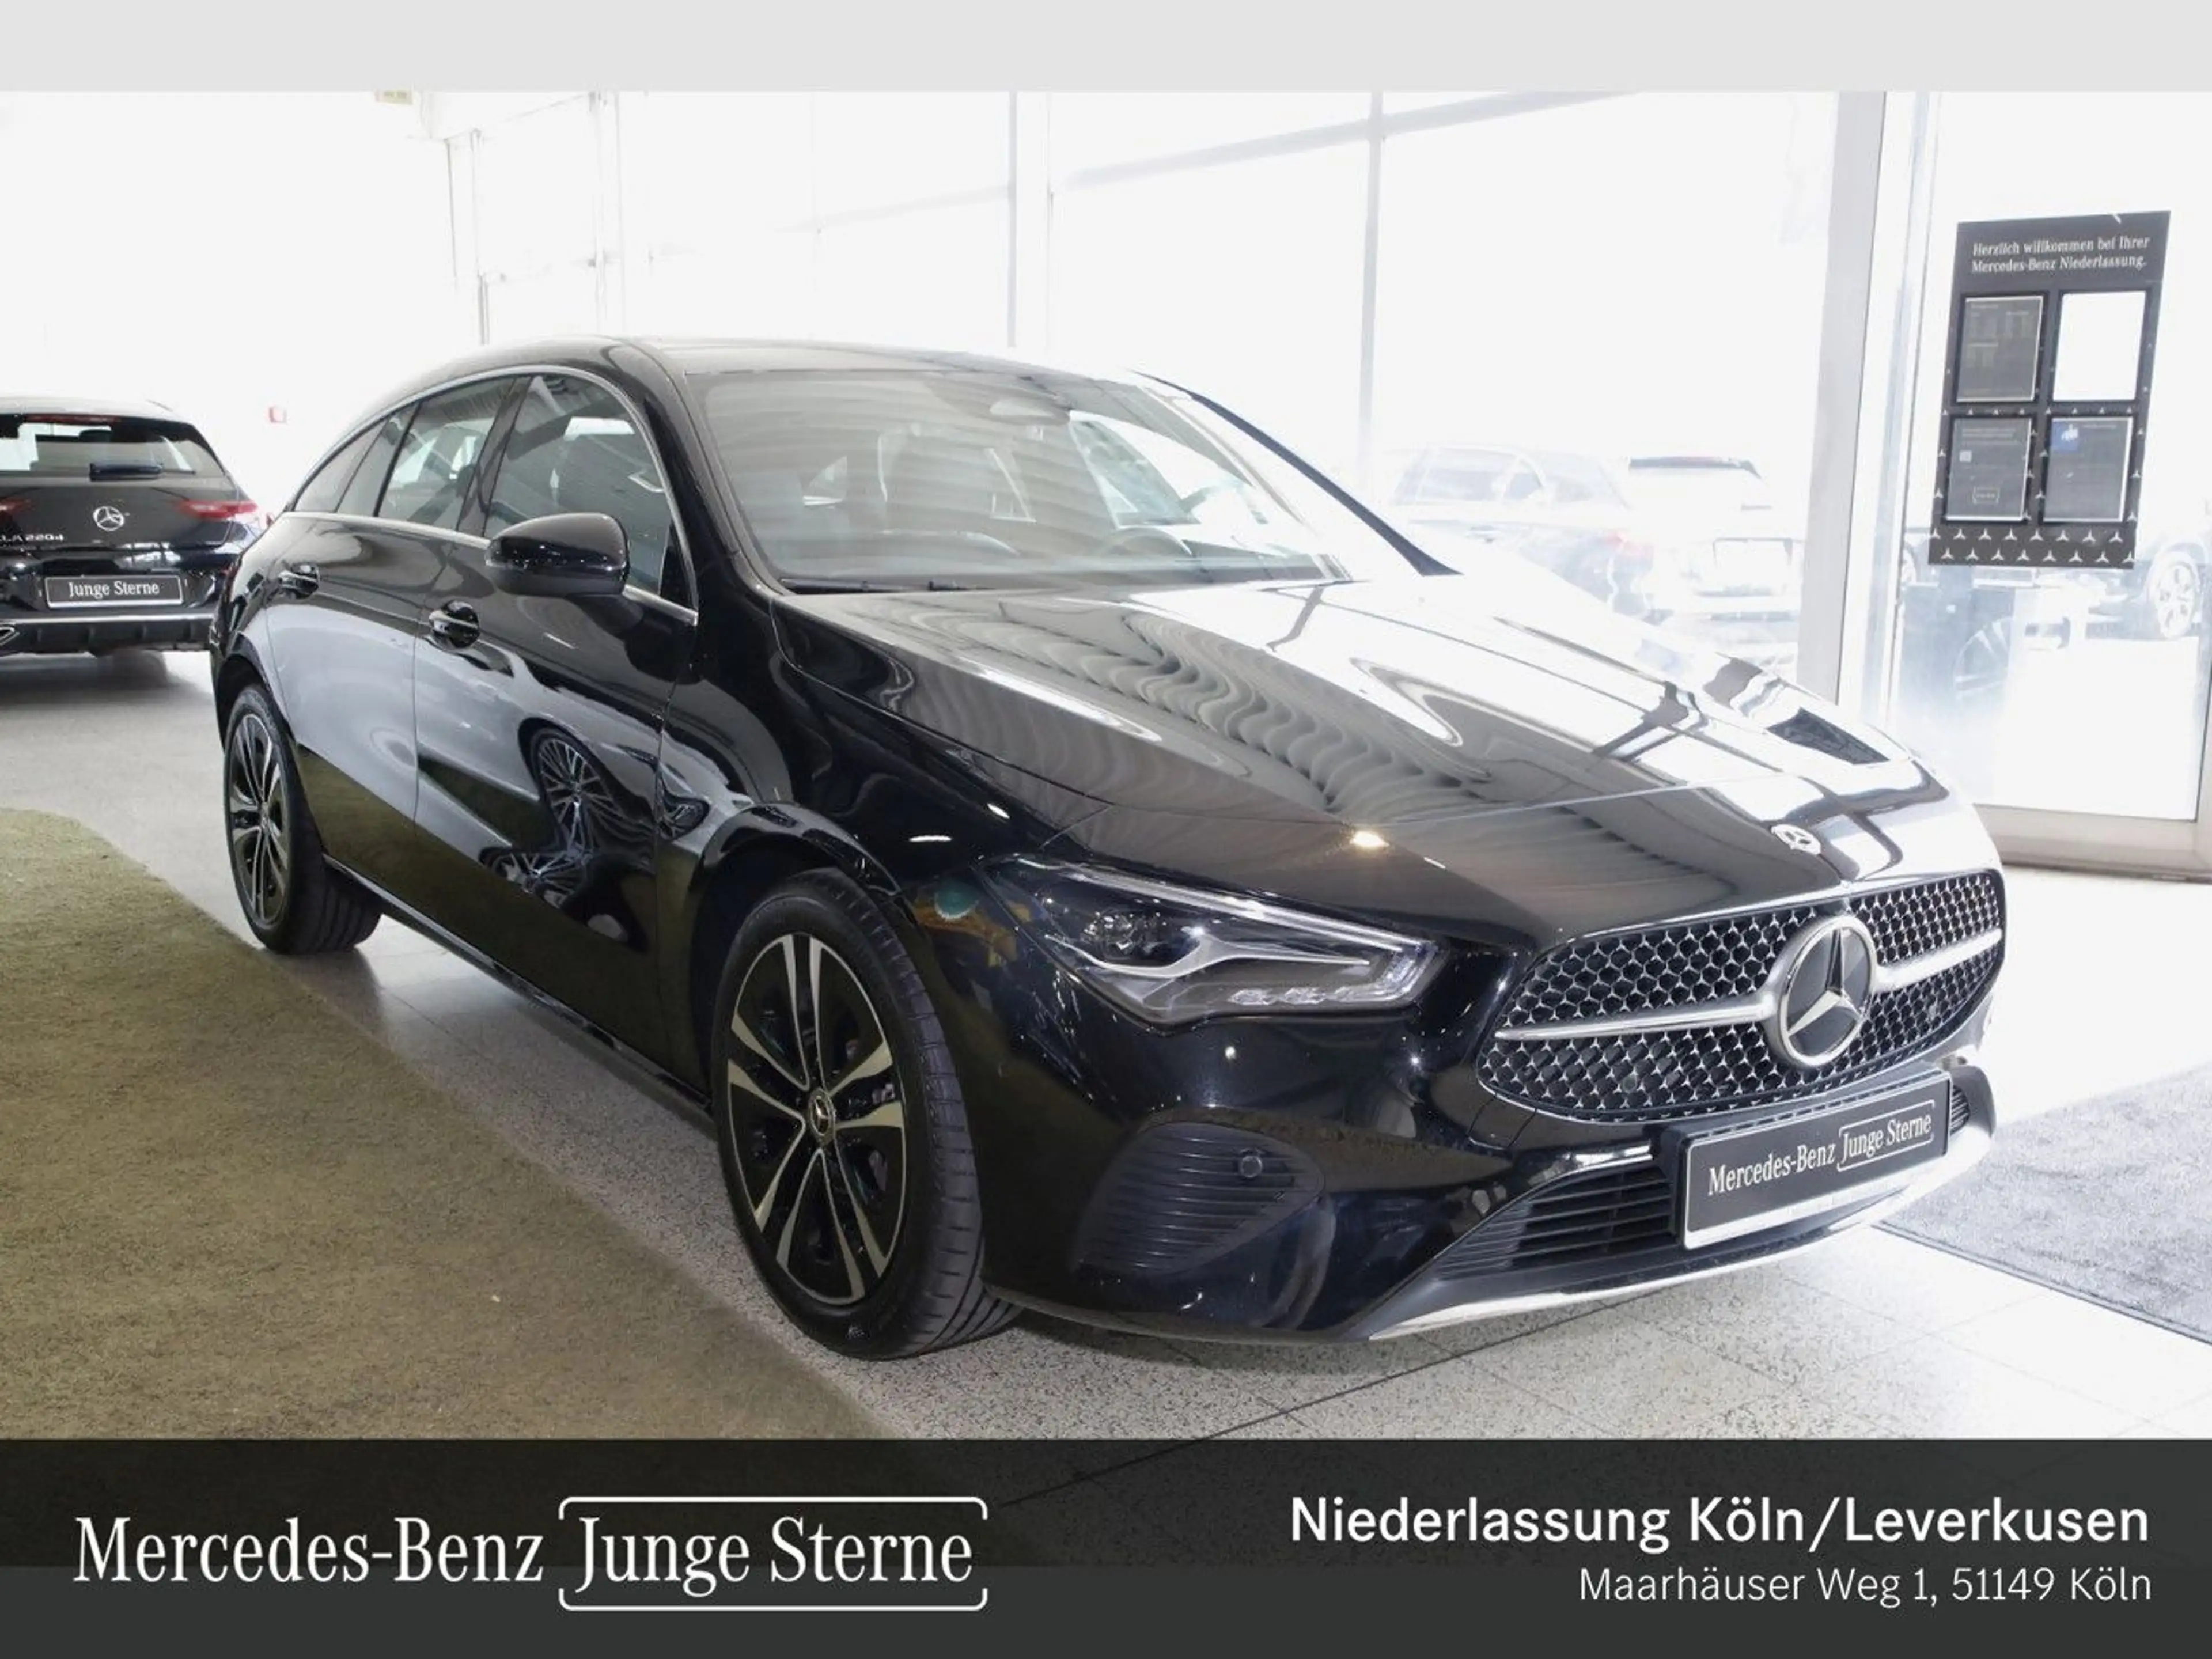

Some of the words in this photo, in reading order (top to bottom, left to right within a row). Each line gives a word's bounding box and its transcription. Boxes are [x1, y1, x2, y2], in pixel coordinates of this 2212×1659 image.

[1972, 241, 2020, 257] Herzlich
[2024, 238, 2094, 255] willkommen
[2097, 236, 2116, 250] bei
[2119, 235, 2151, 249] Ihrer
[1971, 257, 2056, 273] Mercedes-Benz
[2059, 254, 2147, 271] Niederlassung.
[68, 581, 111, 599] Junge
[114, 579, 160, 596] Sterne
[1708, 1142, 1836, 1196] Mercedes-Benz
[1841, 1131, 1885, 1161] Junge
[1887, 1113, 1931, 1146] Sterne
